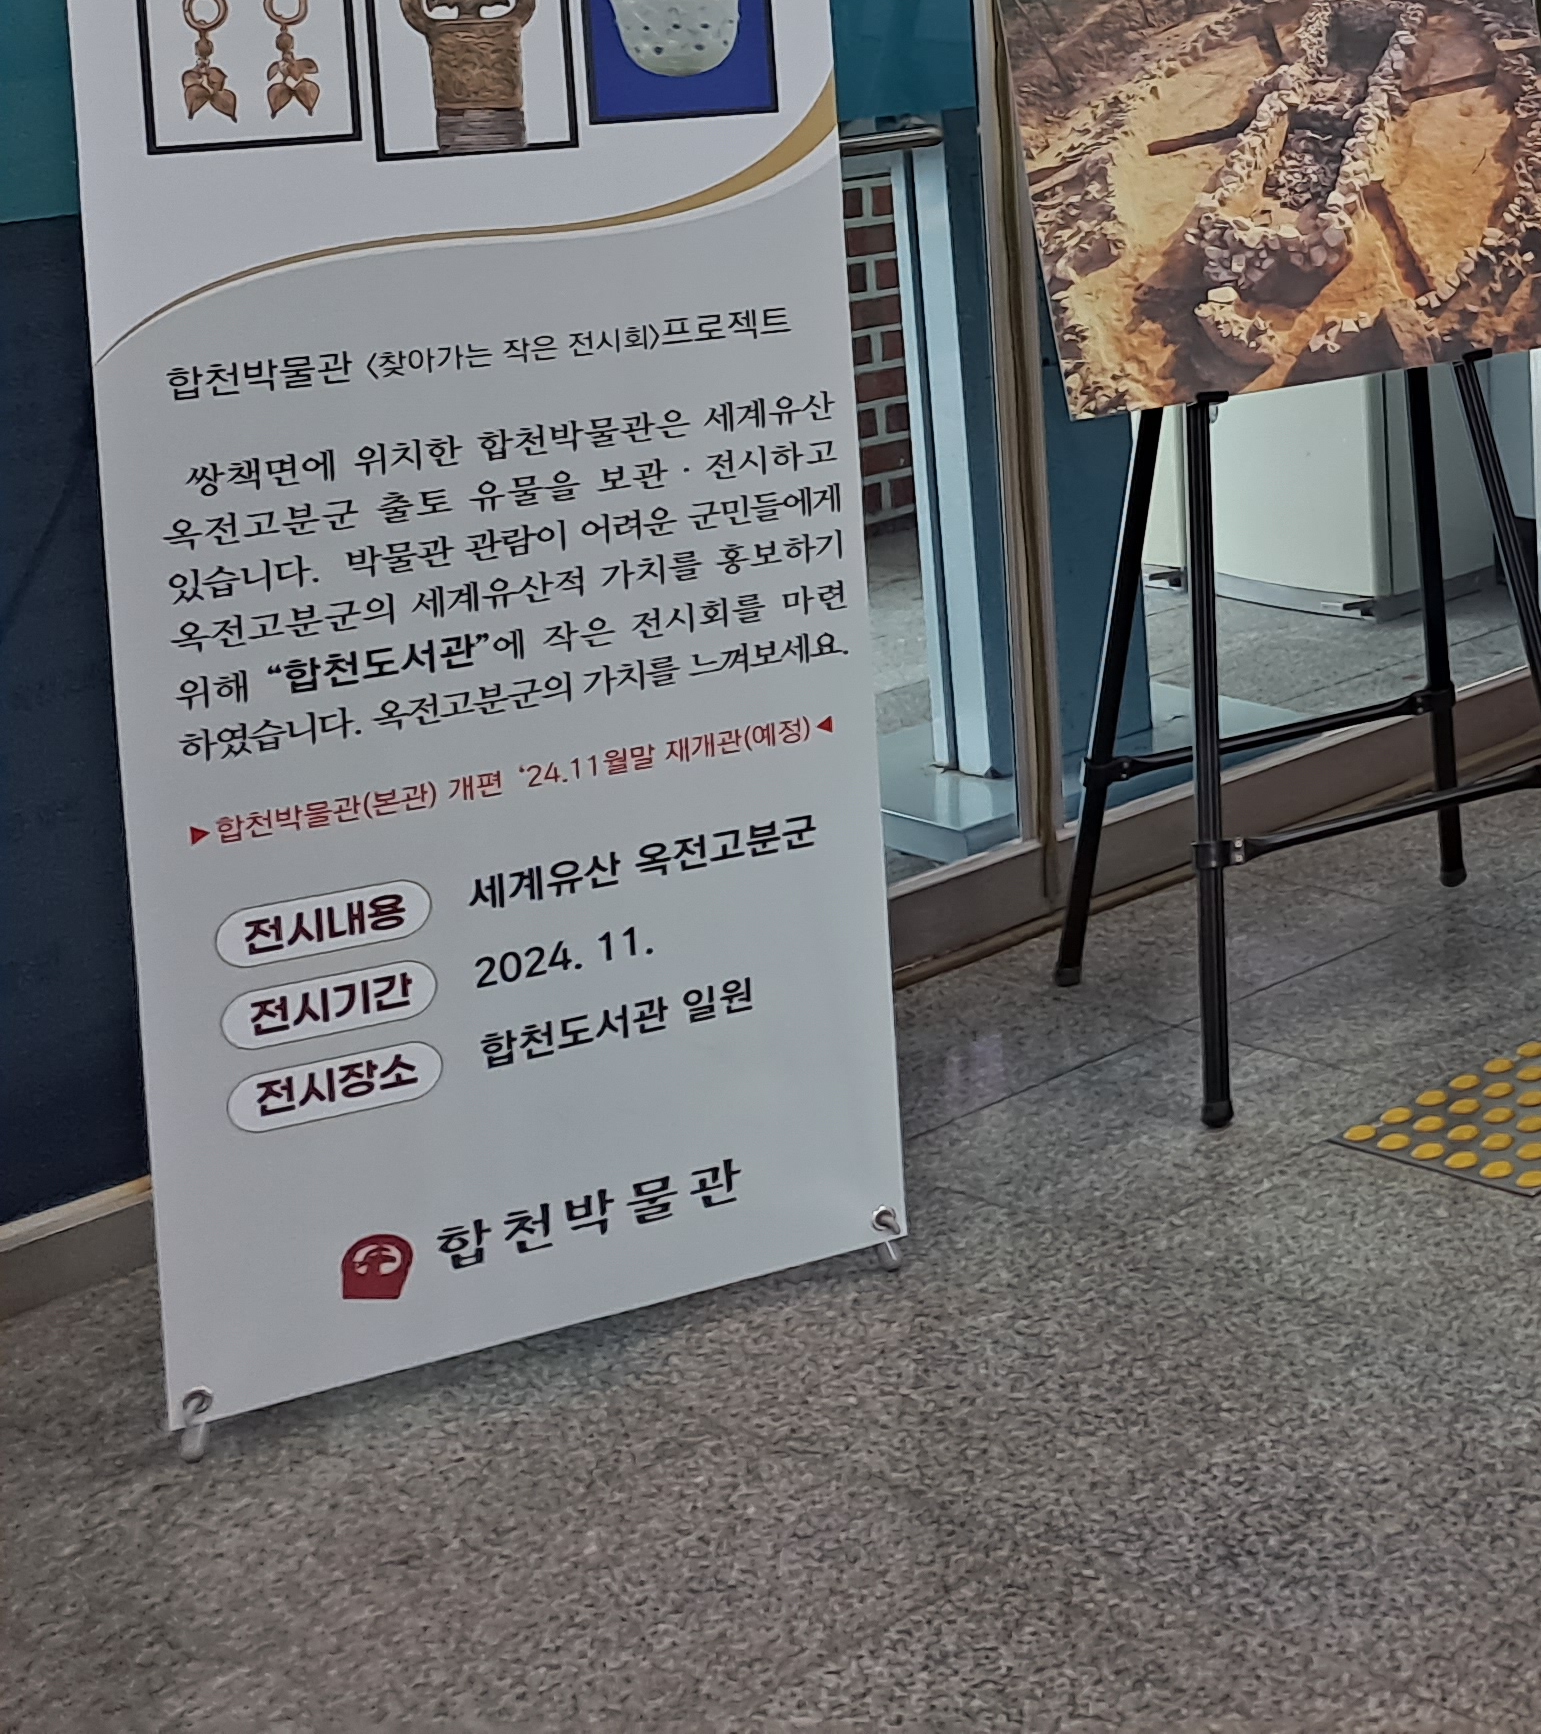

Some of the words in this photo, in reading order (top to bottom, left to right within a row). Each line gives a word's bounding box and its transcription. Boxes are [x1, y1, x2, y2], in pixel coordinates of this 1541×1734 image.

[166, 351, 352, 400] 합천박물관
[503, 336, 558, 363] 작은
[163, 499, 358, 550] 옥전고분군
[377, 489, 453, 523] 출토
[469, 470, 580, 512] 유물을
[598, 458, 668, 492] 보관
[706, 441, 837, 479] 전시하고
[186, 449, 334, 496] 쌍책면에
[354, 435, 463, 476] 위치한
[477, 410, 690, 461] 합천박물관은
[704, 391, 835, 432] 세계유산
[169, 555, 319, 605] 있습니다.
[346, 536, 454, 577] 박물관
[465, 520, 565, 561] 관람이
[581, 507, 677, 544] 어려운
[688, 483, 840, 530] 군민들에게
[171, 593, 394, 652] 옥전고분군의
[412, 566, 584, 617] 세계유산적
[602, 551, 702, 589] 가치를
[717, 529, 842, 574] 홍보하기
[176, 670, 248, 710] 위해
[543, 617, 615, 652] 작은
[632, 594, 765, 639] 전시회를
[782, 580, 847, 615] 마련
[179, 707, 361, 761] 하였습니다.
[373, 671, 571, 730] 옥전고분군의
[584, 656, 680, 696] 가치를
[689, 632, 848, 676] 느껴보세요.
[216, 781, 436, 843] 합천박물관(본관)
[449, 771, 502, 800] 개편
[666, 716, 810, 762] 재개관(예정)
[469, 852, 621, 908] 세계유산
[635, 815, 816, 875] 옥전고분군
[245, 894, 406, 955] 전시내용
[475, 941, 582, 988] 2024.
[598, 927, 653, 961] 11.
[251, 972, 412, 1036] 전시기간
[480, 996, 668, 1069] 합천도서관
[683, 977, 752, 1023] 일원
[257, 1054, 418, 1116] 전시장소
[437, 1159, 741, 1269] 합천박물관
